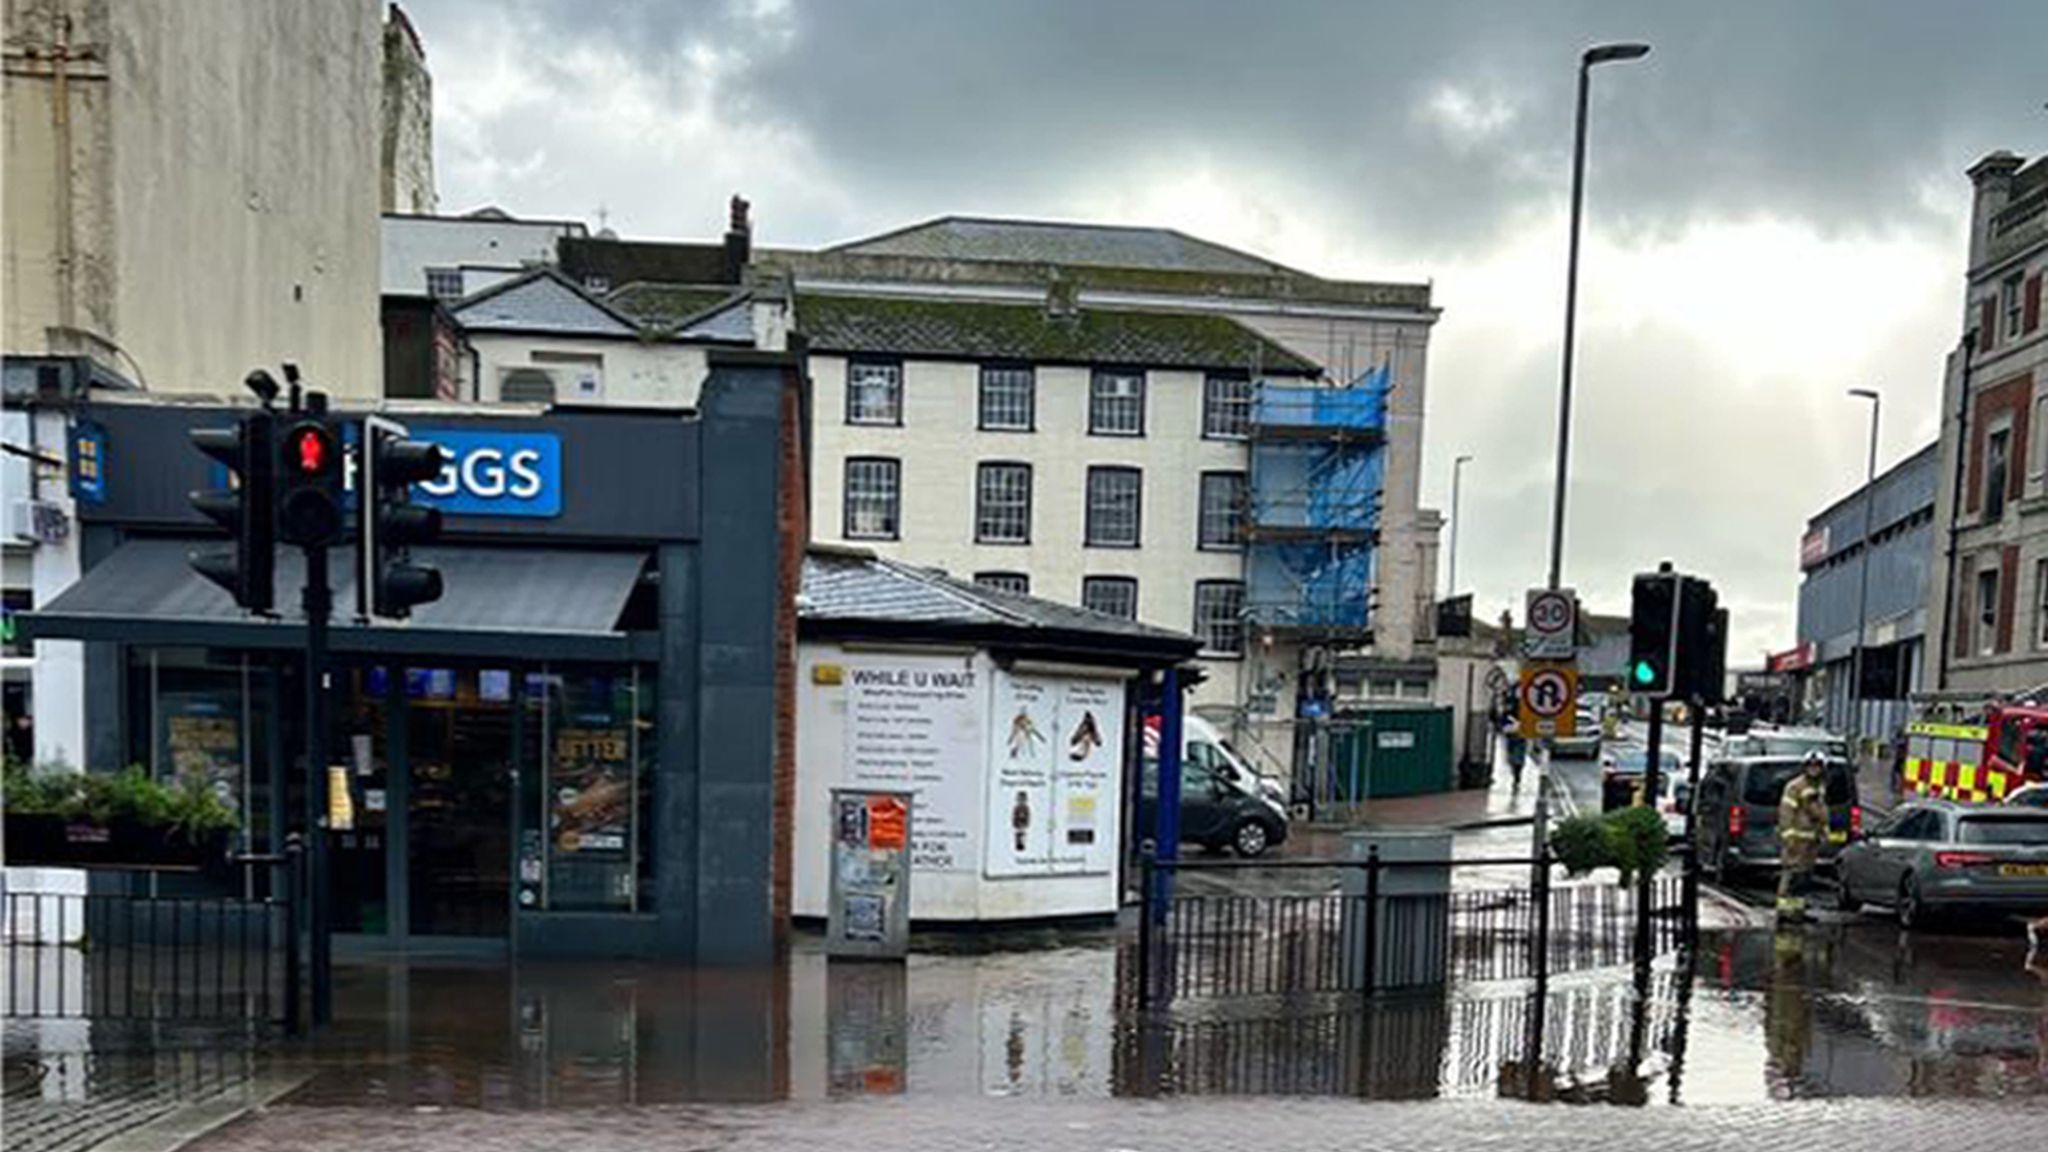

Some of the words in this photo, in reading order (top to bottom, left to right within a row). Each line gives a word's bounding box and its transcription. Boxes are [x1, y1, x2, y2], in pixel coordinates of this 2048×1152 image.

[1536, 604, 1565, 622] 30
[852, 670, 909, 687] WHILE
[913, 672, 929, 688] U
[932, 673, 976, 689] WAIT
